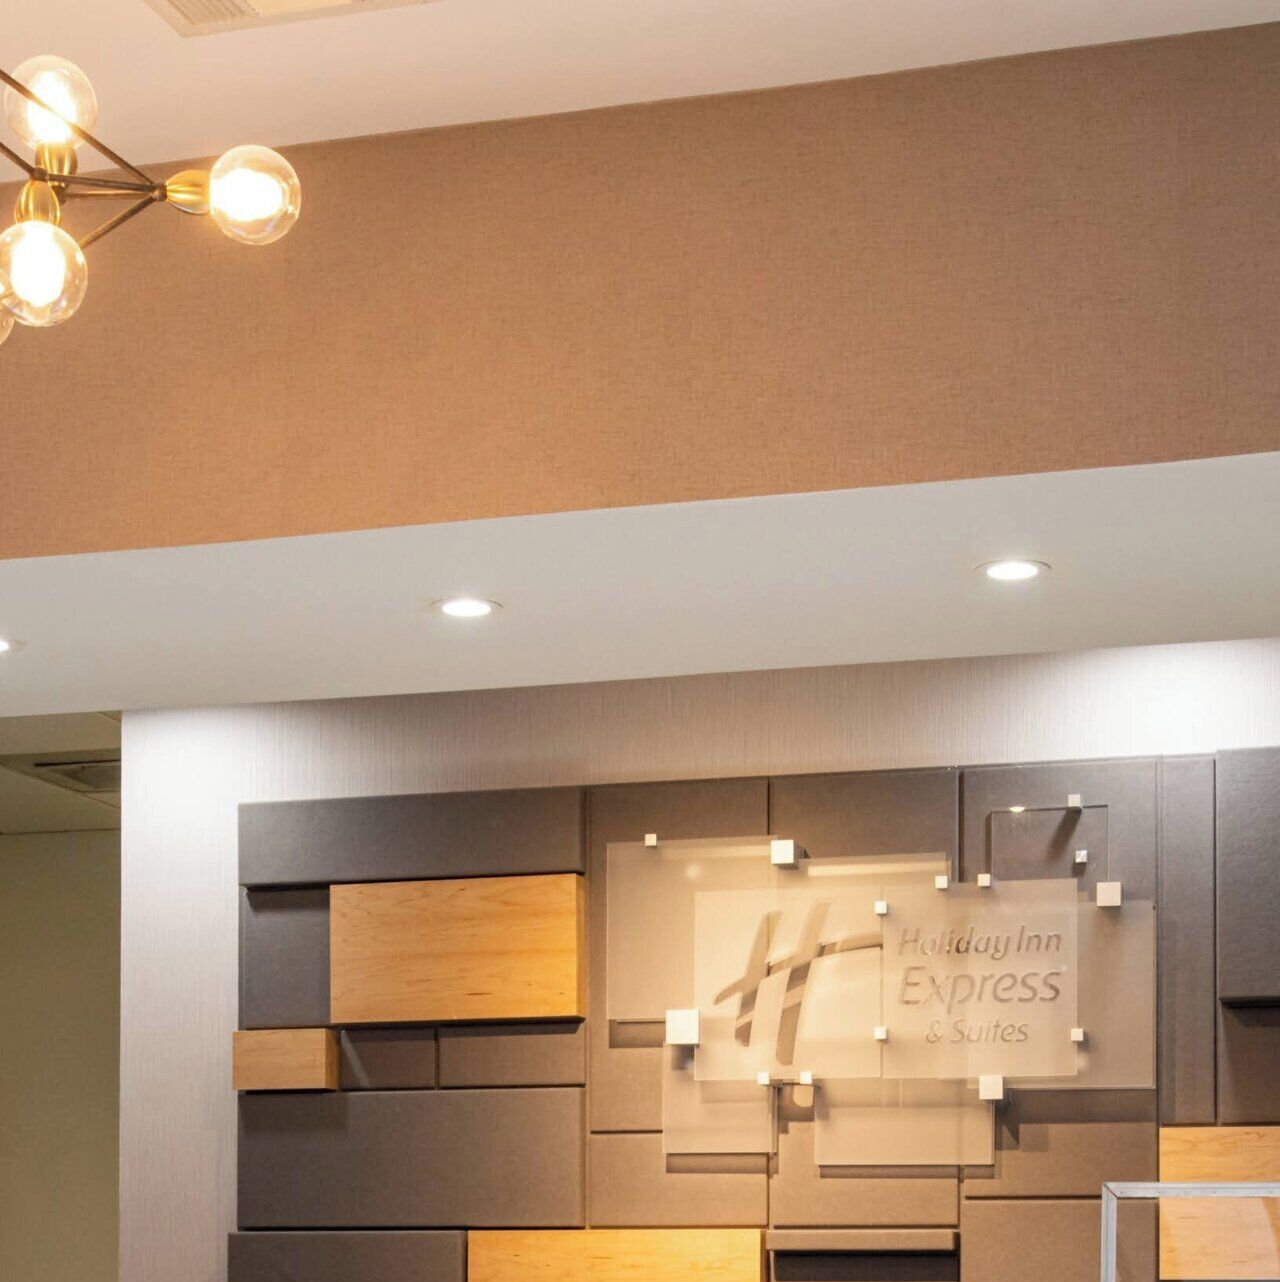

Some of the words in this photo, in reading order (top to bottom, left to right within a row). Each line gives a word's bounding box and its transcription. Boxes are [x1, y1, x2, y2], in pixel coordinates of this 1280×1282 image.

[897, 926, 1011, 960] Holiday
[1017, 925, 1062, 953] Inn
[899, 965, 1062, 1015] Express
[925, 1020, 943, 1044] &
[951, 1018, 1029, 1043] Suites
